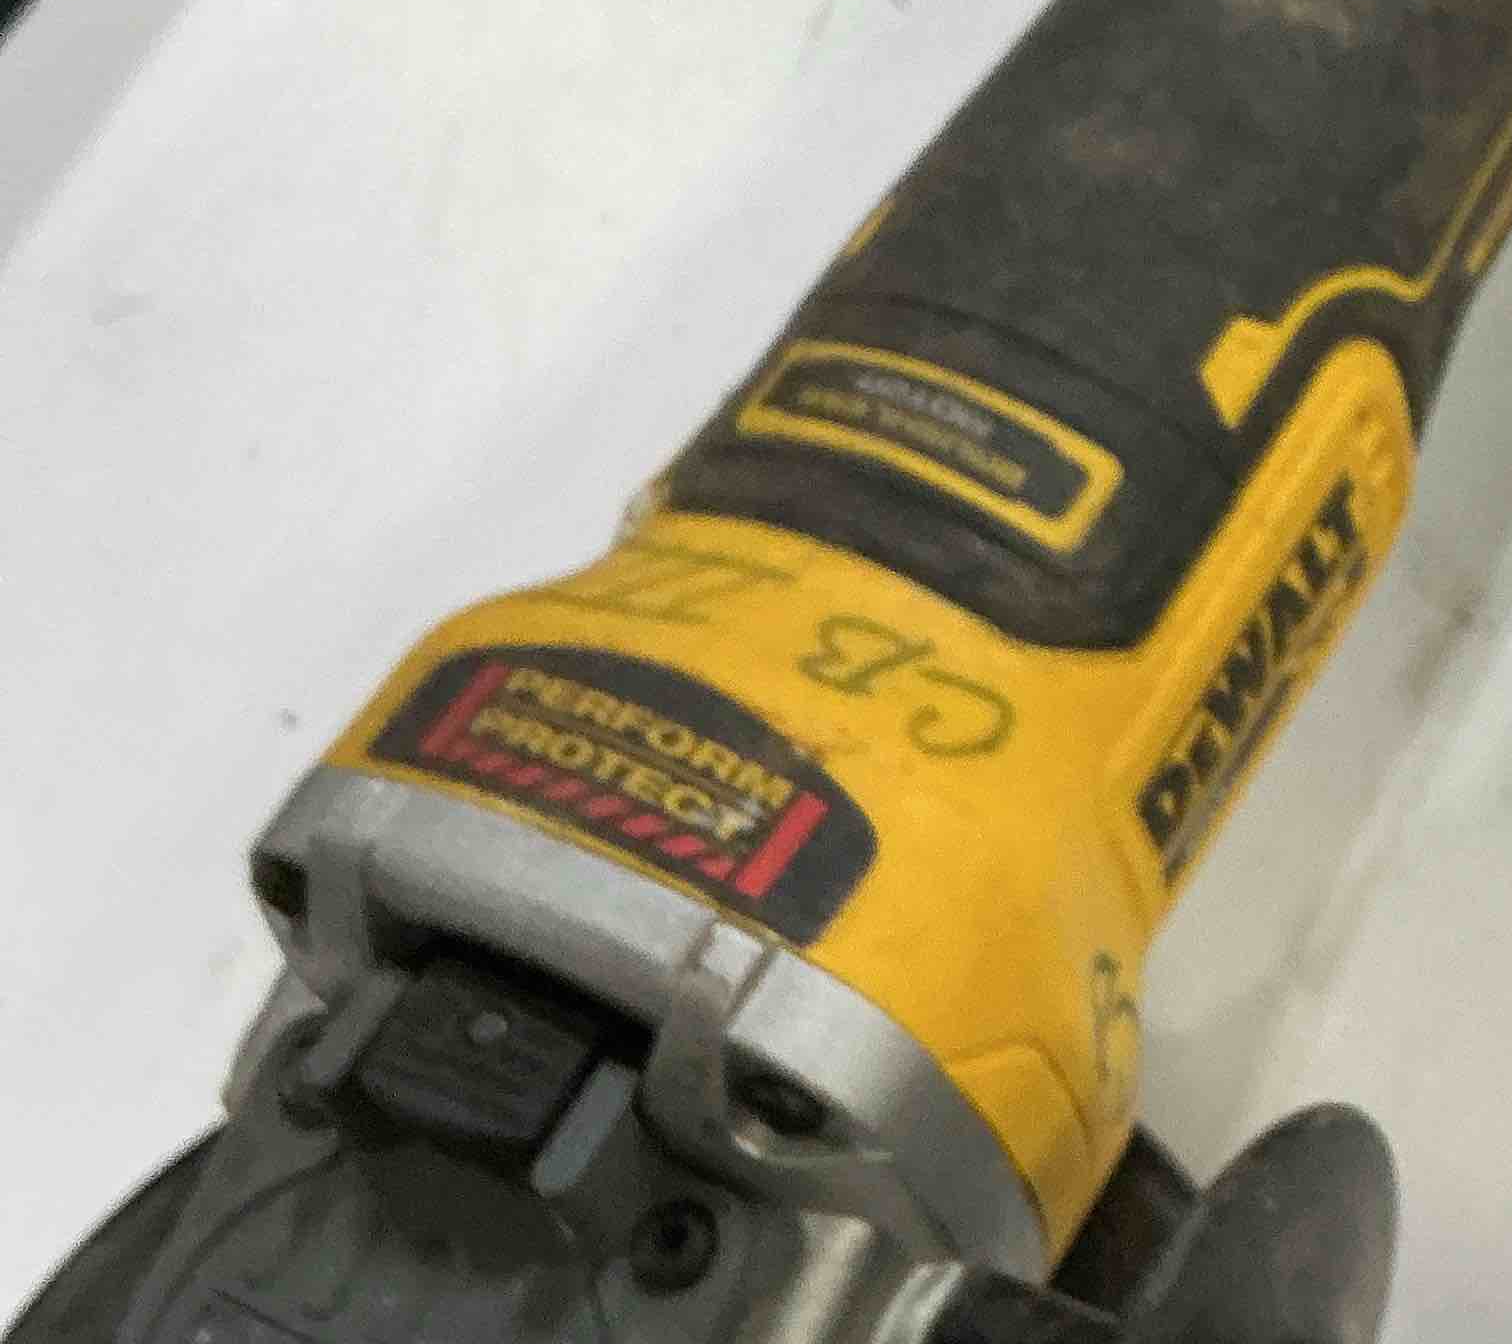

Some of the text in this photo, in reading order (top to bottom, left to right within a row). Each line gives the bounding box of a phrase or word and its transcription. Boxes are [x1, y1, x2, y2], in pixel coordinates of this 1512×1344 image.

[502, 665, 795, 814] PERFORM
[1134, 467, 1362, 874] DEWALT
[469, 706, 776, 842] PROTECT
